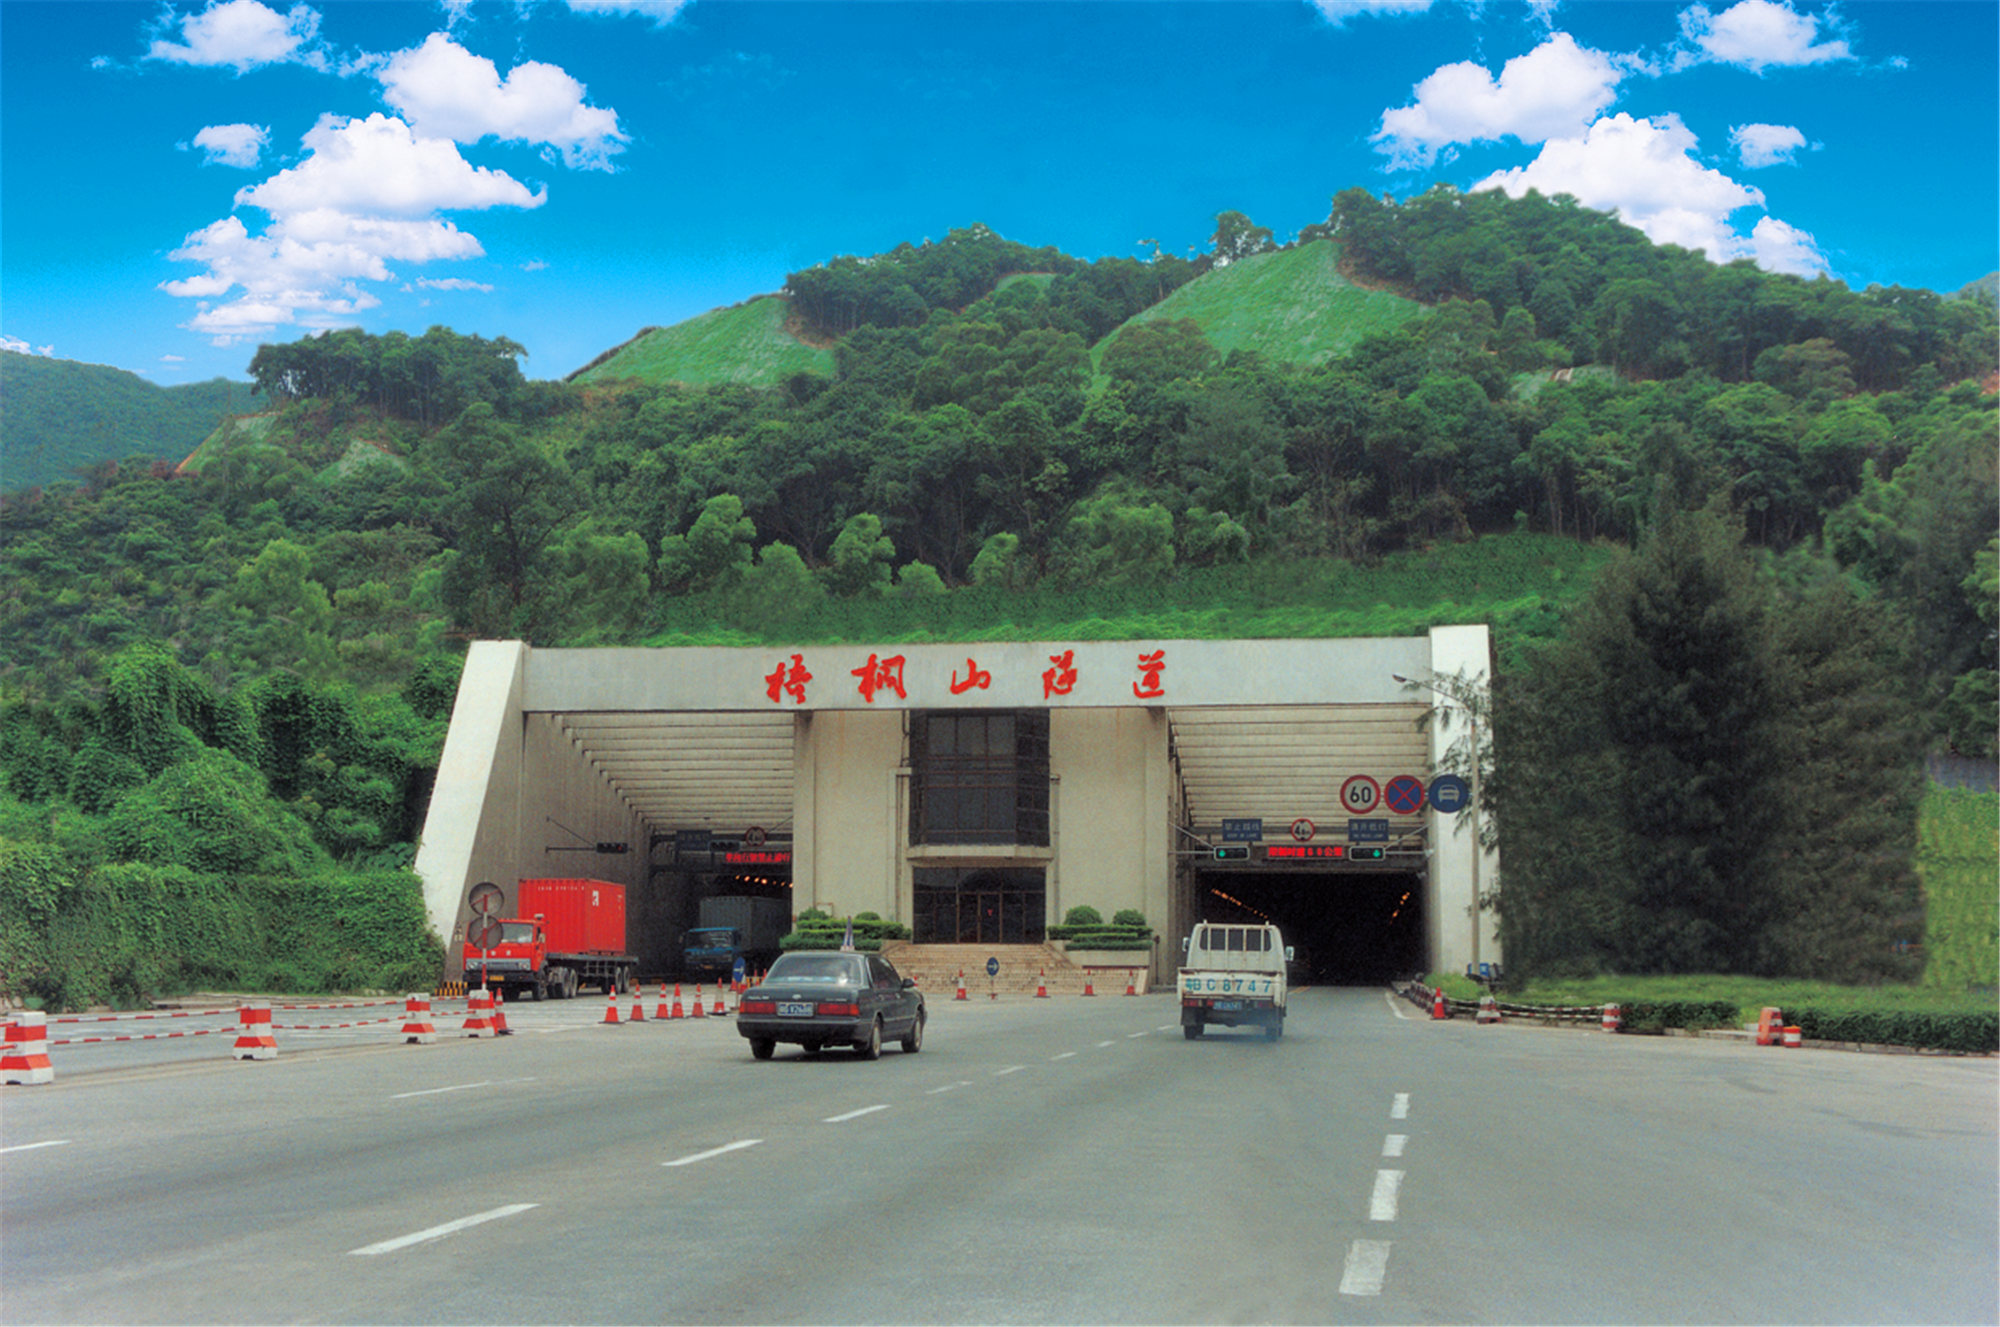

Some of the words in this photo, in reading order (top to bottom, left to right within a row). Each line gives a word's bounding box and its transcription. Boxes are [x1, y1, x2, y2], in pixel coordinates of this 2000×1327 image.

[764, 649, 1166, 705] 梧桐山隧道
[1349, 786, 1372, 804] 60
